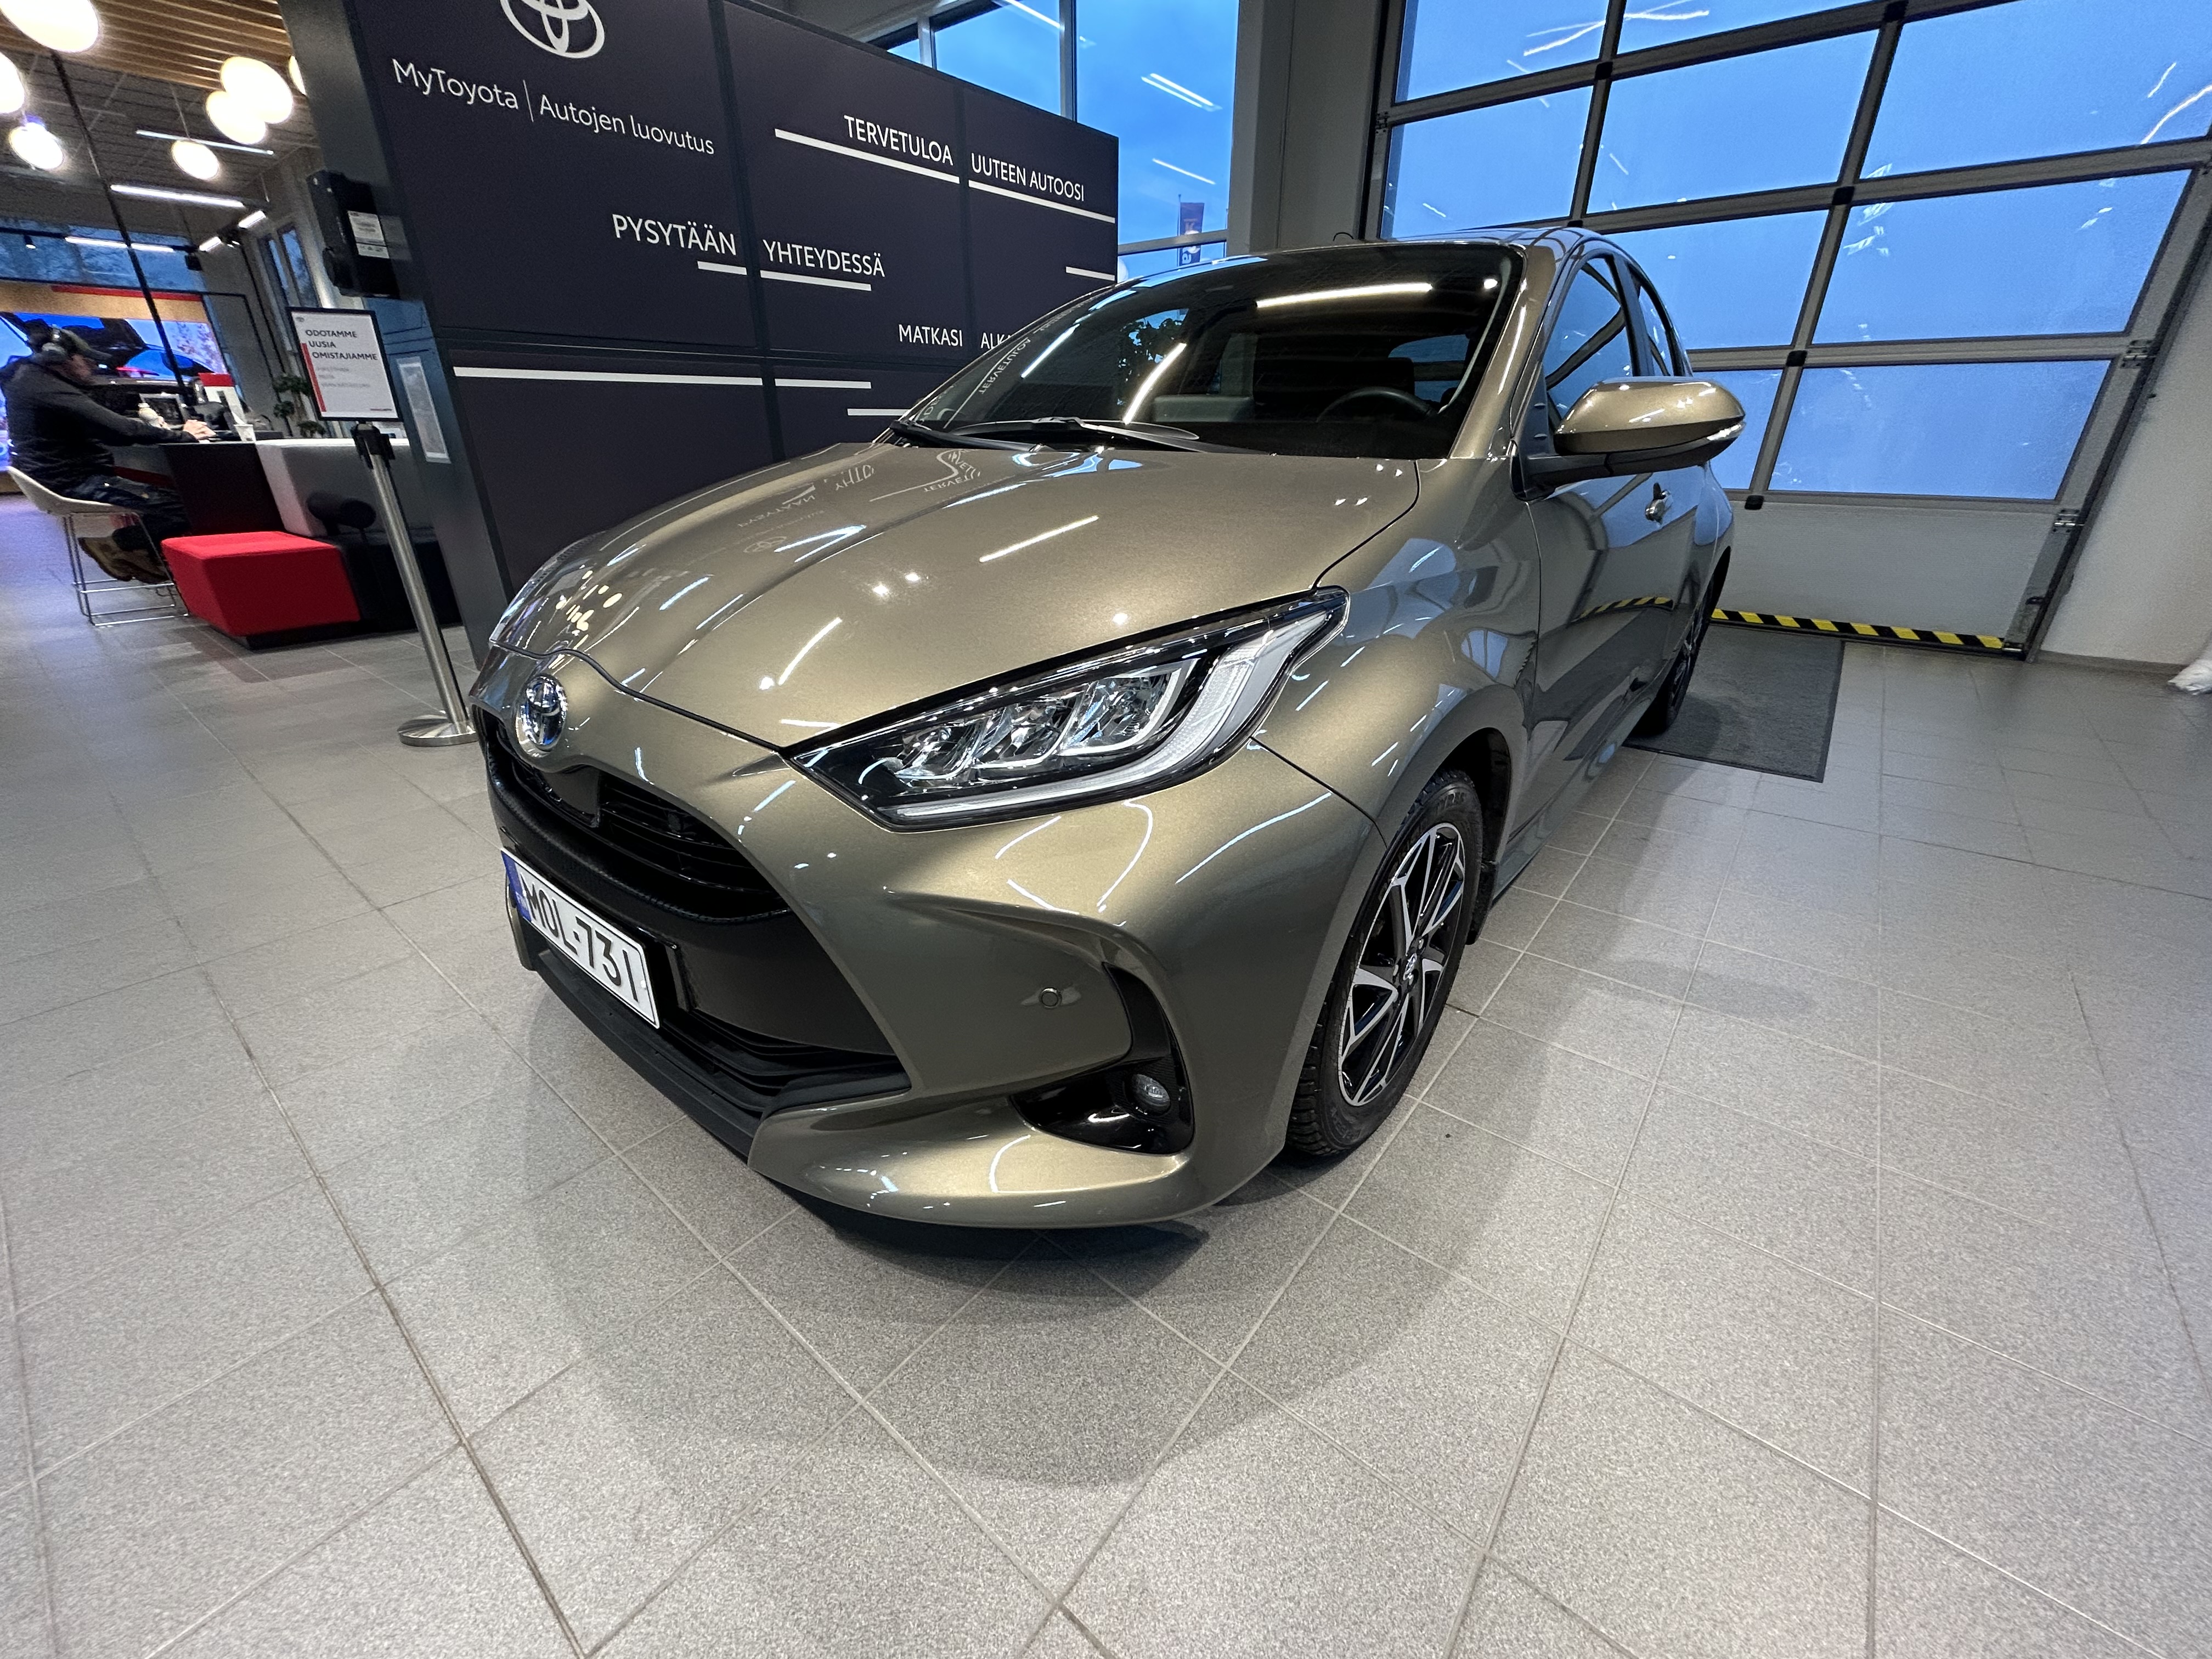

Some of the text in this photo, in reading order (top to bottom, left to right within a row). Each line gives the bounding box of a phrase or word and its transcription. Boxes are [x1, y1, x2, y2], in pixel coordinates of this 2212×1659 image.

[392, 59, 715, 155] MyToyota Autojen luovutus
[843, 115, 1085, 202] TERVETULOA UUTEEN AUTOOSI
[612, 213, 885, 278] PYSYTÄÄN YHTEYDESSÄ
[305, 330, 358, 338] ODOTAMME
[312, 352, 379, 360] OMISTAJIAMME
[898, 324, 1012, 349] MATKASI ALK
[520, 873, 639, 1003] MOL-731
